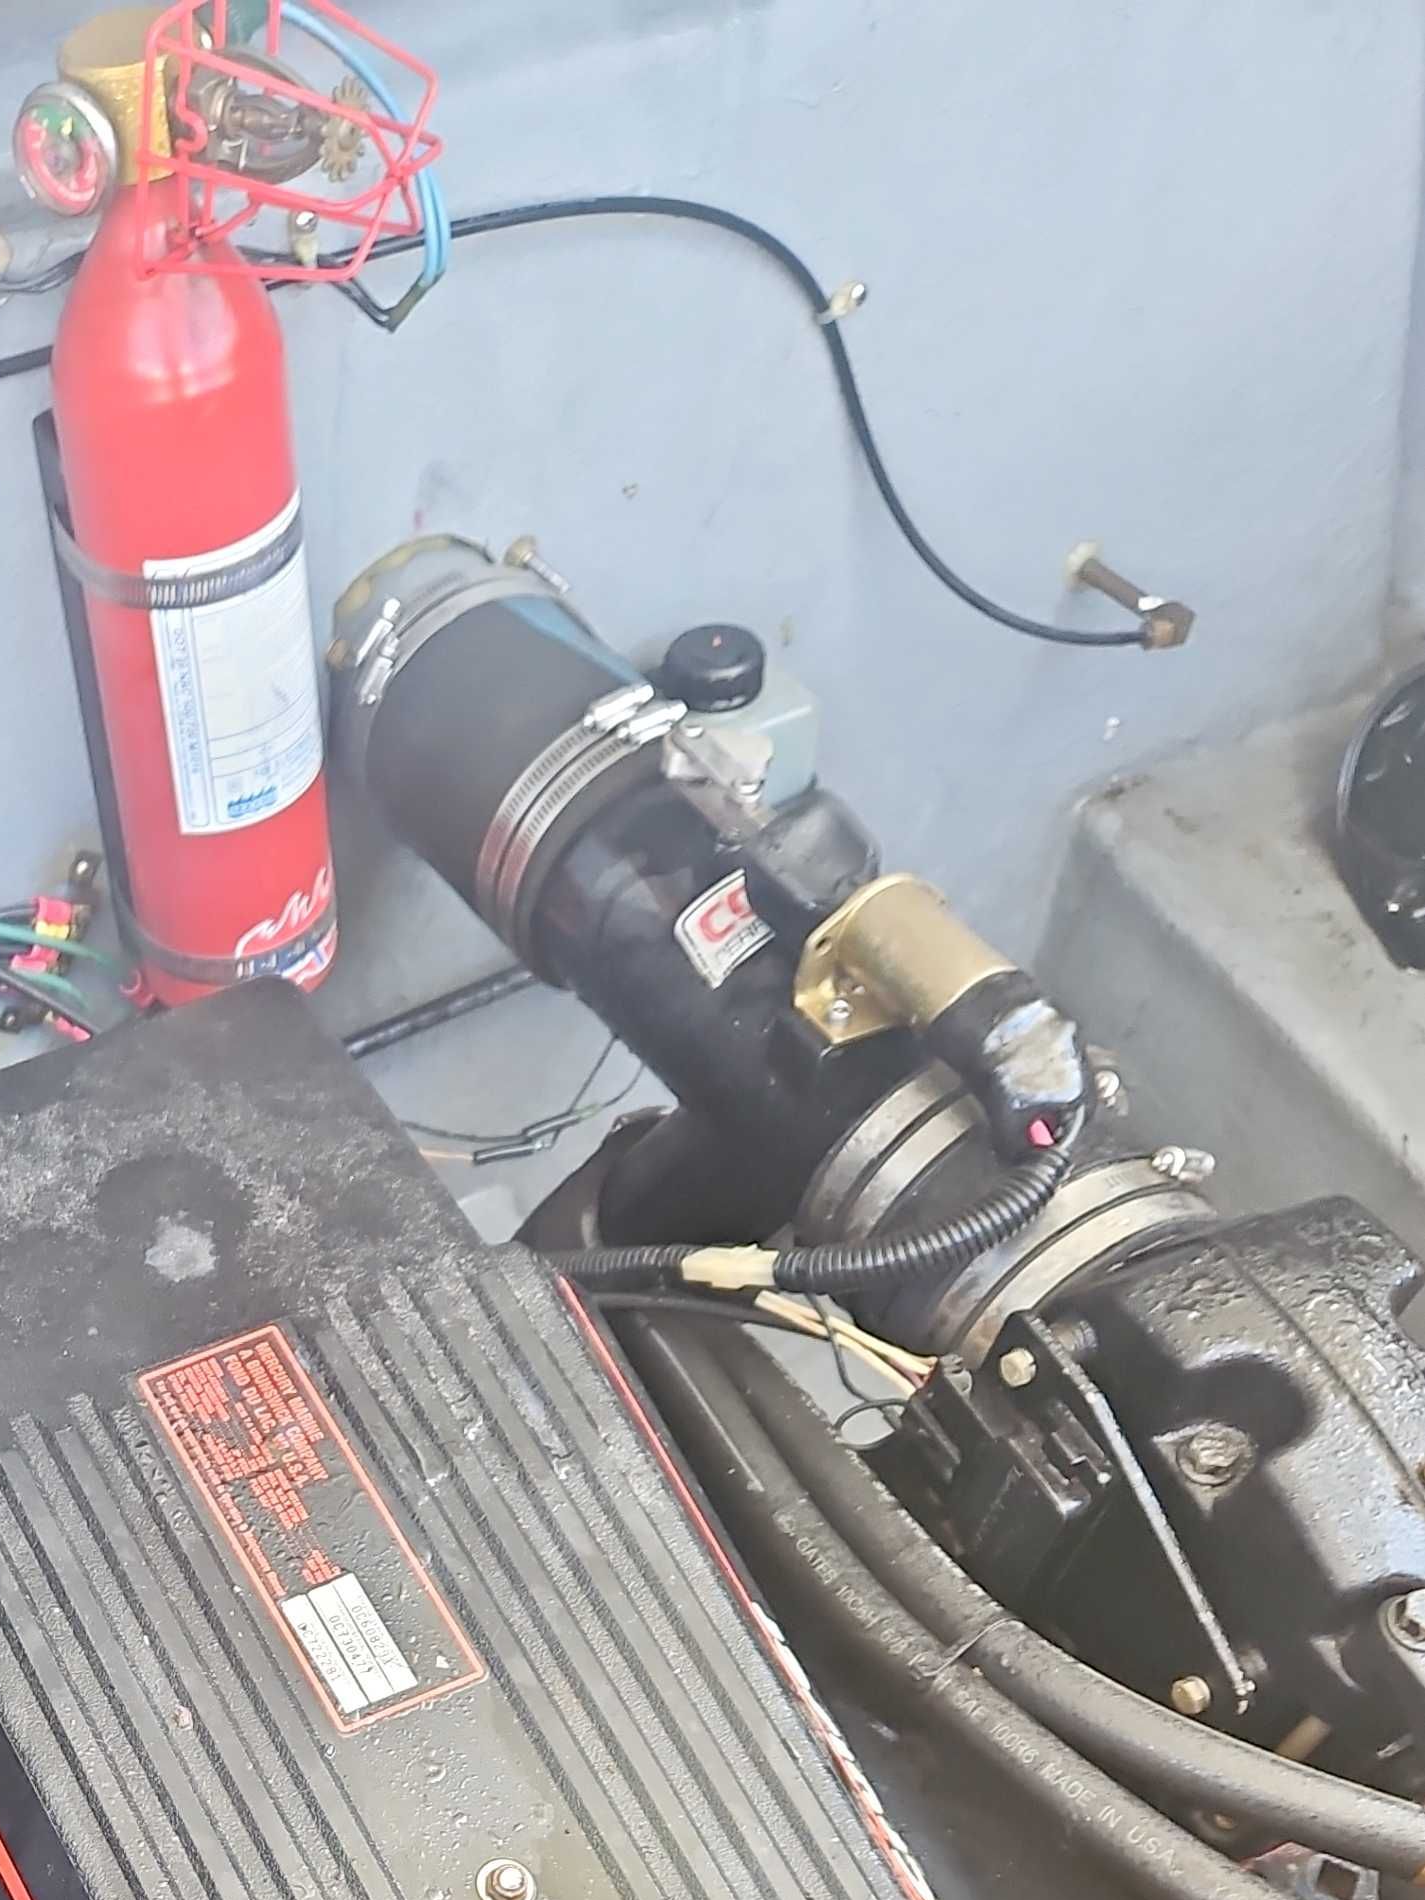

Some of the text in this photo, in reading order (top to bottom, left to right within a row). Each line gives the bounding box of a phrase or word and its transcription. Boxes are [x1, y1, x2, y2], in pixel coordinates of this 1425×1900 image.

[222, 1352, 251, 1388] FOND
[241, 1384, 264, 1407] DU
[237, 1345, 254, 1360] A
[245, 1357, 295, 1427] BRUNSWICK
[253, 1339, 297, 1399] MERCURY
[286, 1394, 325, 1445] MARINE
[284, 1423, 329, 1484] COMPANY
[1038, 1760, 1098, 1811] MADE
[1095, 1803, 1124, 1830] IN
